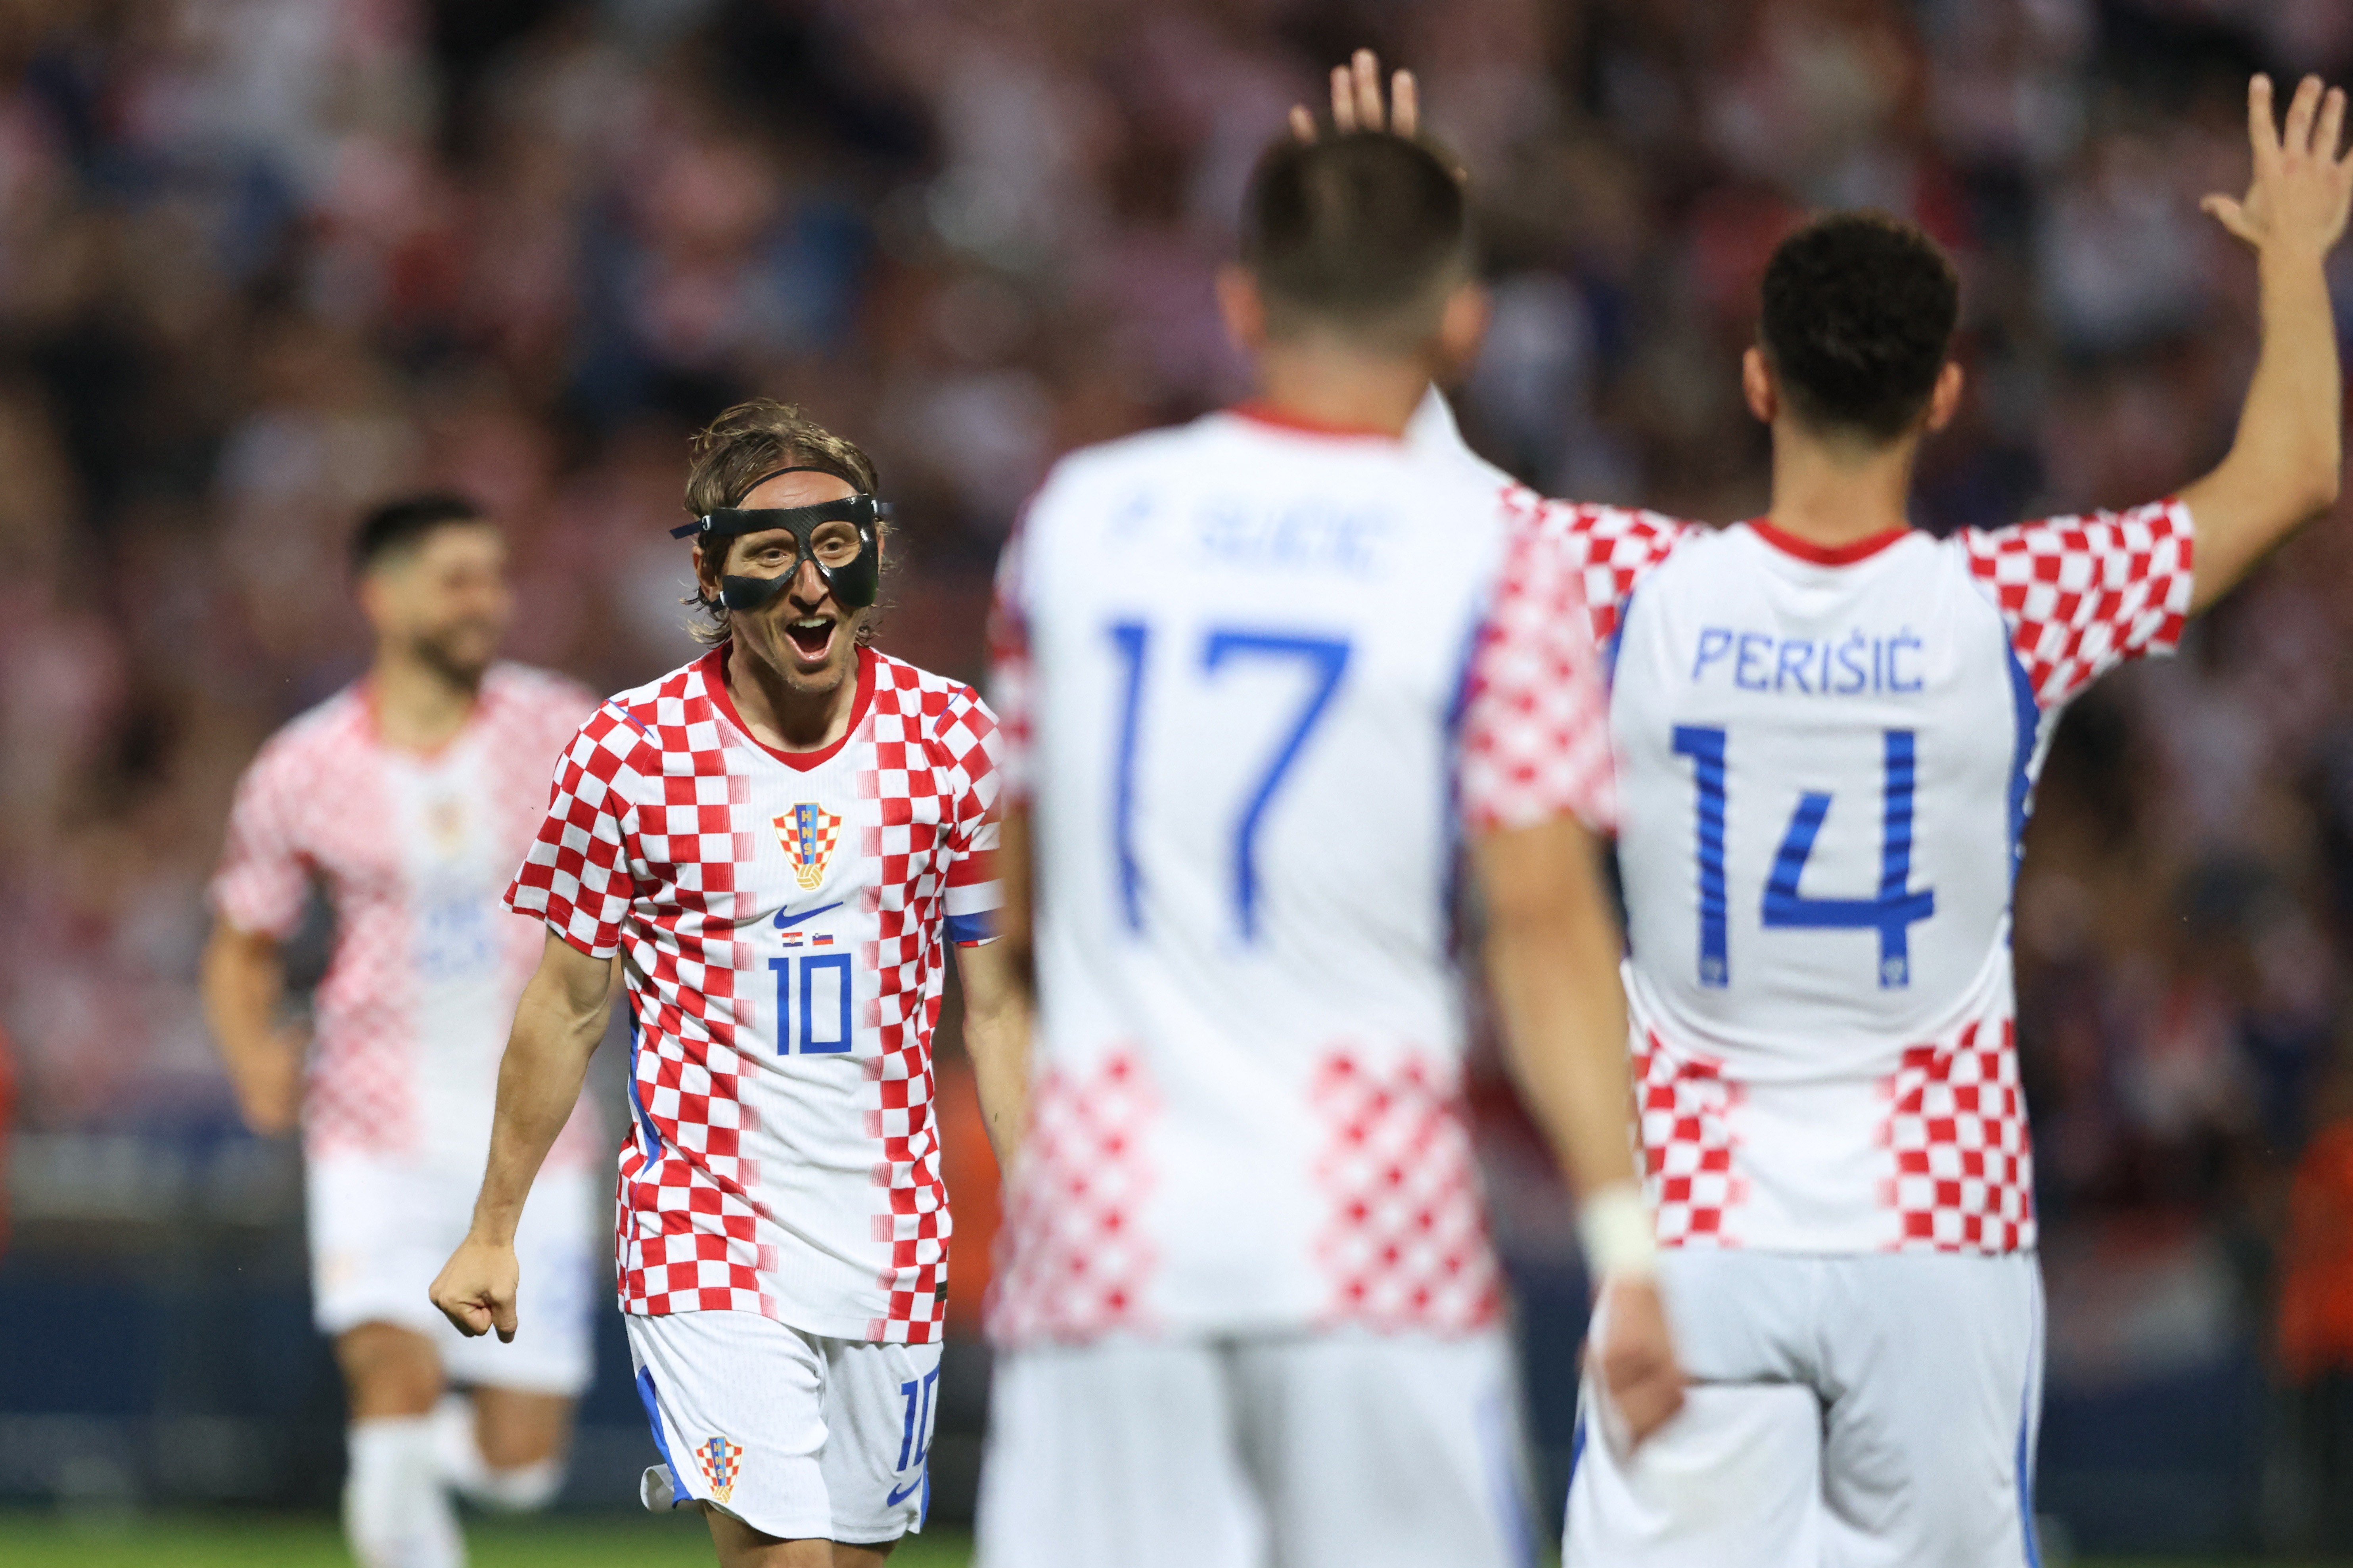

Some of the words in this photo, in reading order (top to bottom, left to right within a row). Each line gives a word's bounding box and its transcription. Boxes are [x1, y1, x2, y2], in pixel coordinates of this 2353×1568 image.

[1102, 613, 1356, 947] 17
[801, 810, 813, 855] HNS
[1672, 723, 1934, 987] 14
[768, 953, 852, 1055] 10
[713, 1442, 724, 1479] HNS
